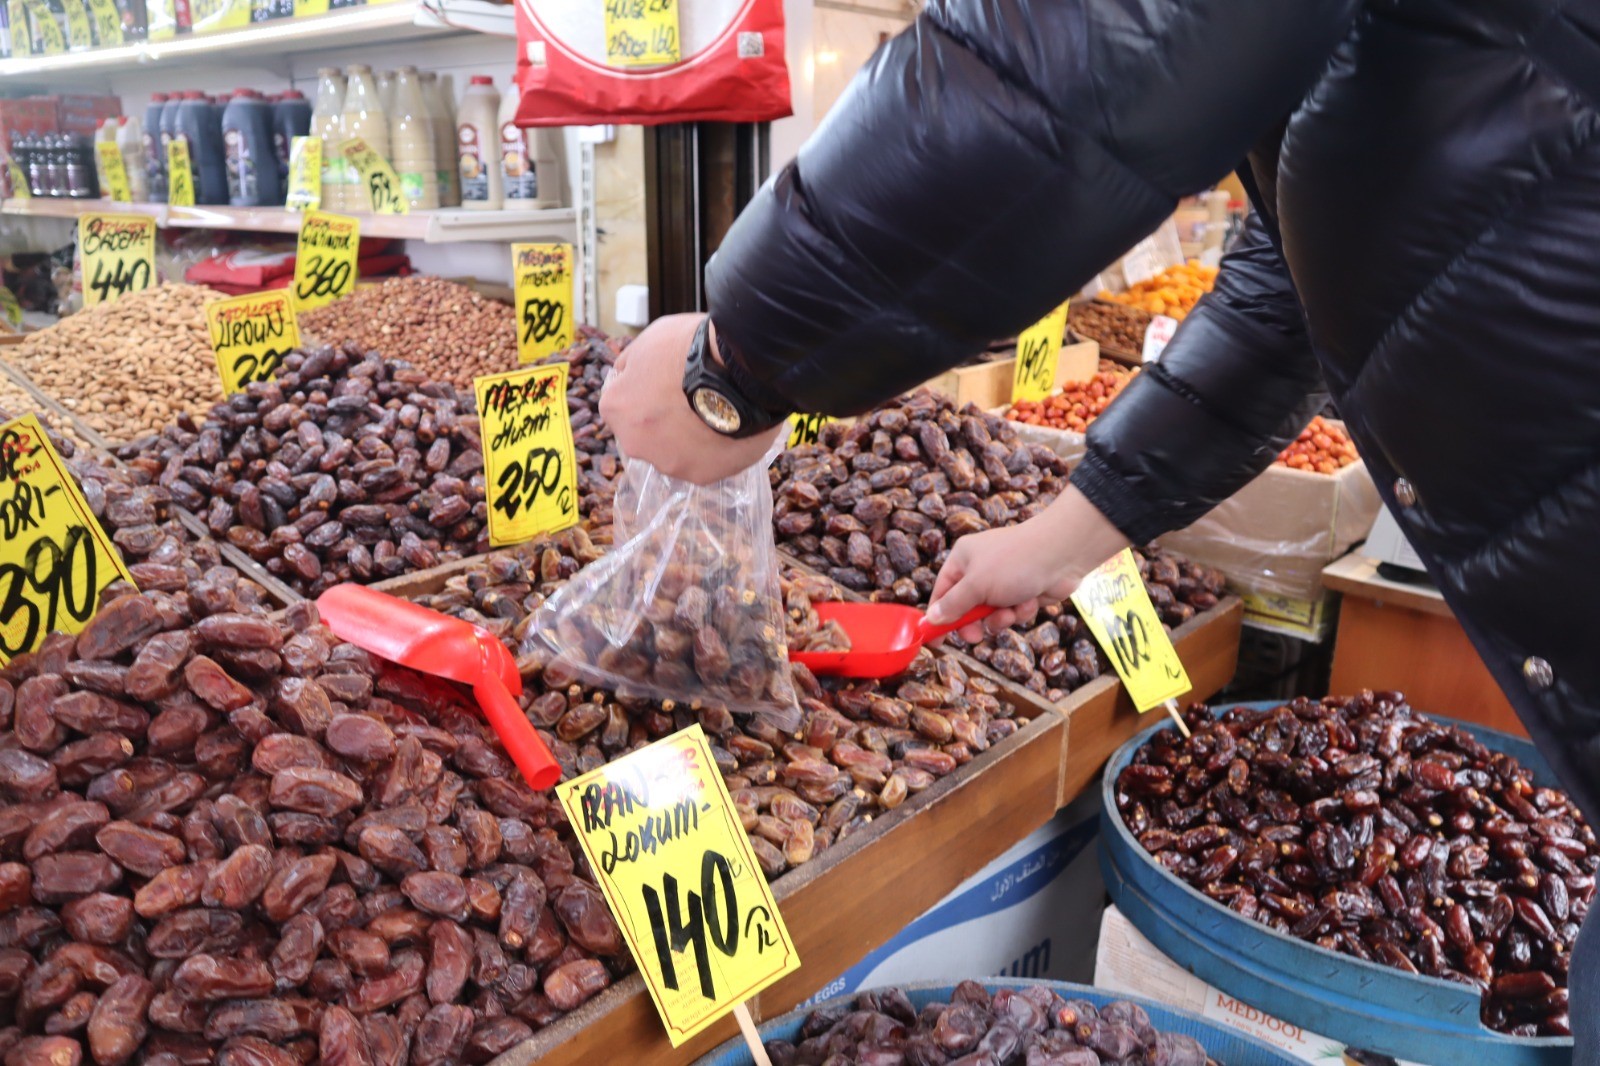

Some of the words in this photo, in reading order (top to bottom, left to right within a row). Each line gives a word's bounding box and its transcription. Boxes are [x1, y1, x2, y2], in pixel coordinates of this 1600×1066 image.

[91, 257, 150, 303] 440
[297, 254, 351, 300] 360
[523, 298, 564, 346] 580
[233, 347, 293, 389] 22
[1017, 336, 1049, 386] 140
[493, 447, 562, 521] 250
[0, 524, 97, 659] 390
[642, 849, 739, 1001] 140
[814, 976, 847, 1005] EGGS
[1216, 992, 1307, 1044] MEDJOOL
